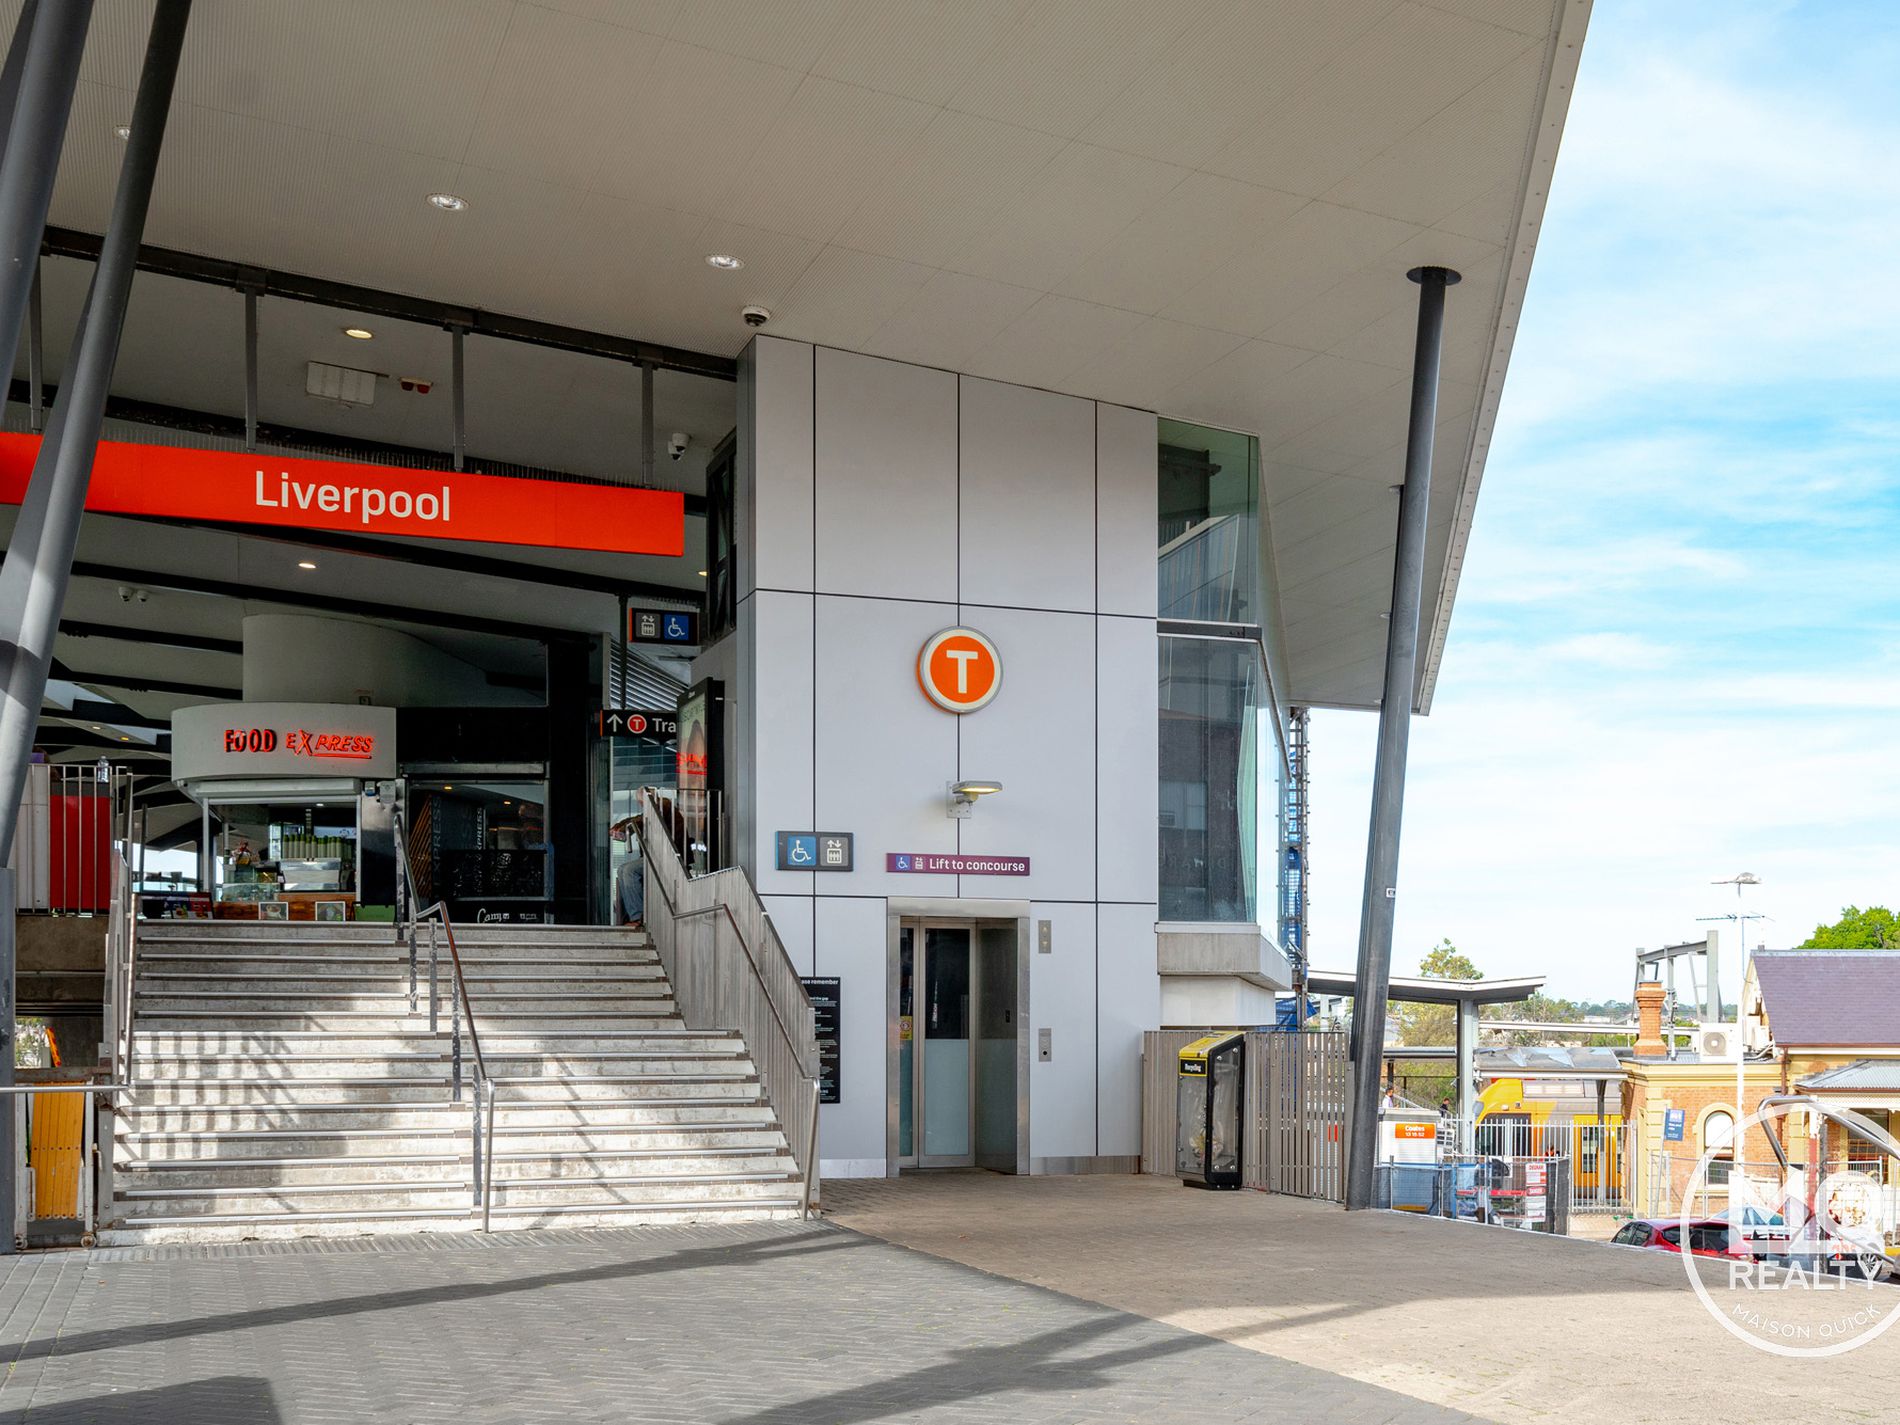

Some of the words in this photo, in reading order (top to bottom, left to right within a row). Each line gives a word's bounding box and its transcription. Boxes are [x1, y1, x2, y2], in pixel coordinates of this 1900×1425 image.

[255, 470, 452, 524] Liverpool
[946, 650, 978, 694] T
[632, 719, 641, 730] T
[223, 728, 277, 753] FOOD
[286, 728, 374, 757] EXPRESS
[929, 857, 950, 872] Lift
[953, 859, 964, 872] to
[966, 860, 1025, 874] concourse
